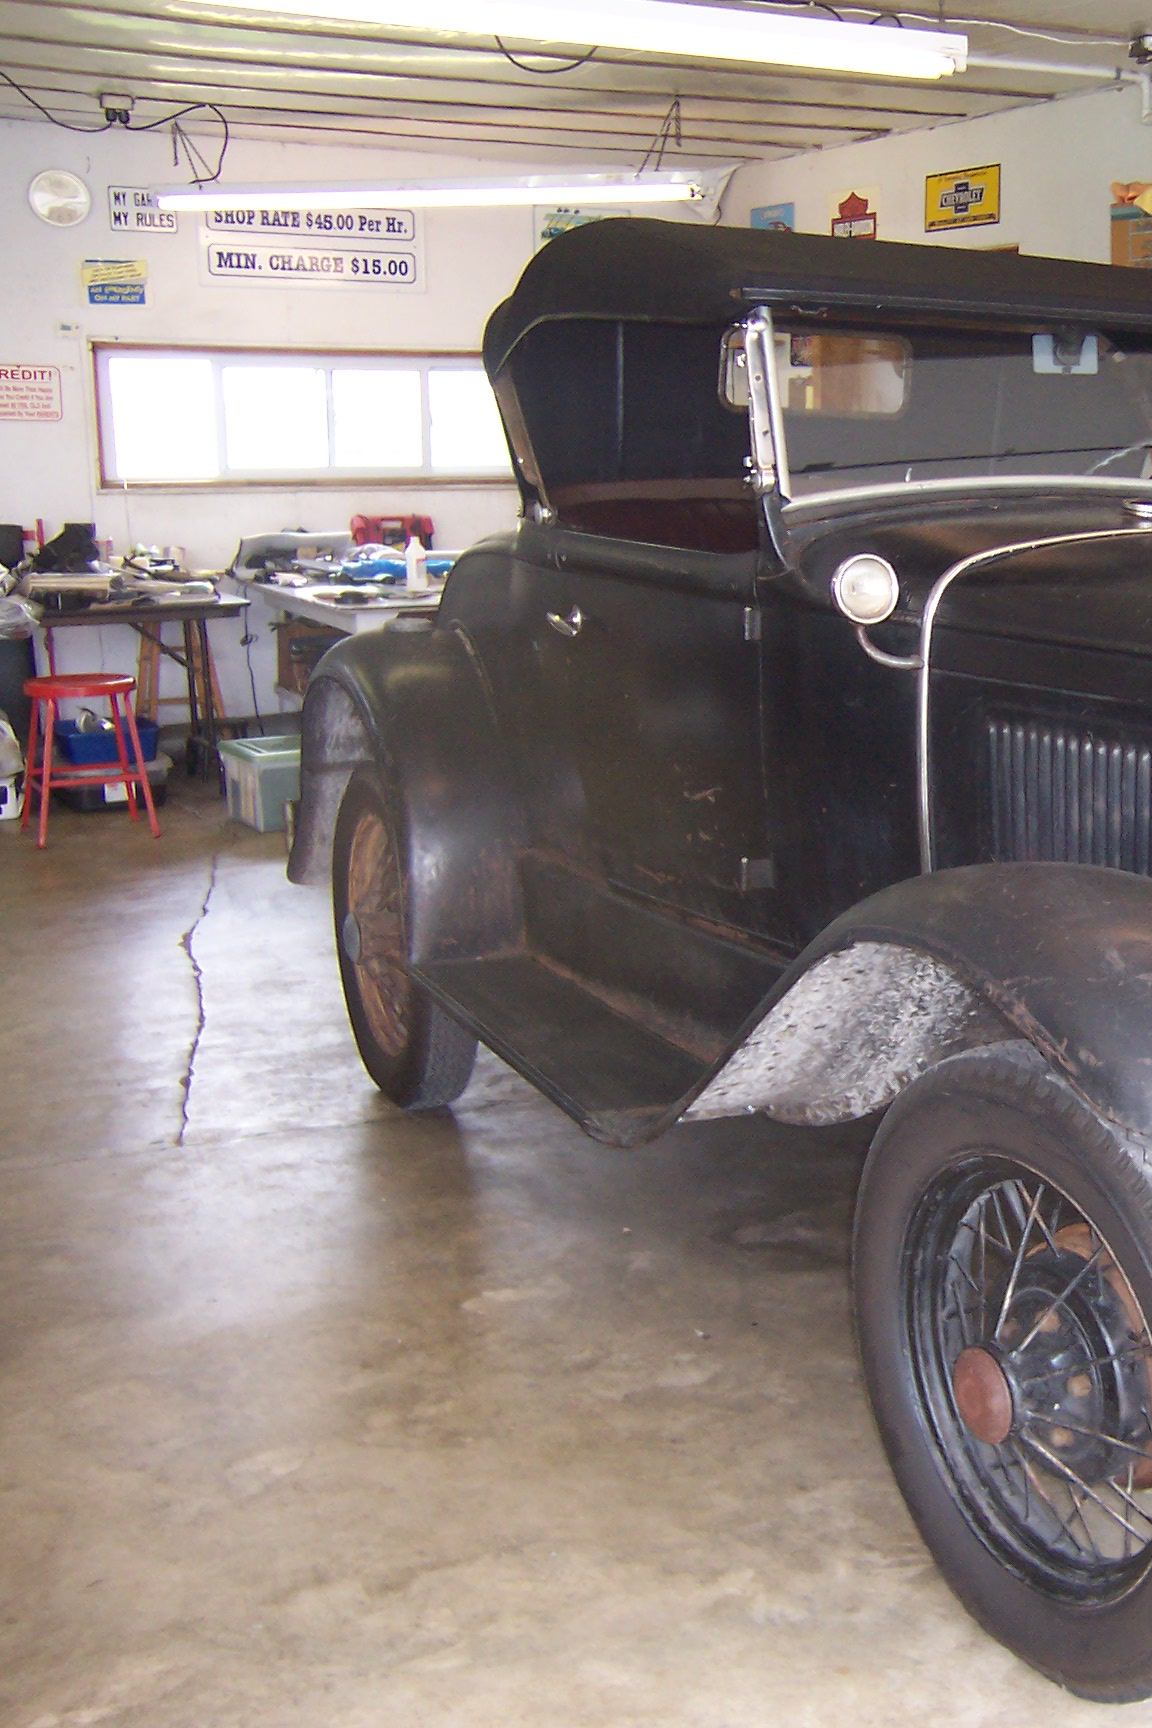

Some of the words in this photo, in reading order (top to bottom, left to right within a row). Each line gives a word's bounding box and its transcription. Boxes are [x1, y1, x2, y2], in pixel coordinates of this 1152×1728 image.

[113, 191, 126, 206] MY
[113, 211, 128, 226] MY
[136, 212, 174, 228] RULES
[214, 210, 255, 225] SHOP
[260, 210, 300, 228] RATE
[305, 213, 354, 231] $45.00
[358, 215, 381, 232] Per
[385, 217, 408, 234] Hr.
[216, 251, 263, 271] MIN.
[269, 254, 345, 274] CHARGE
[350, 258, 409, 277] $15.00
